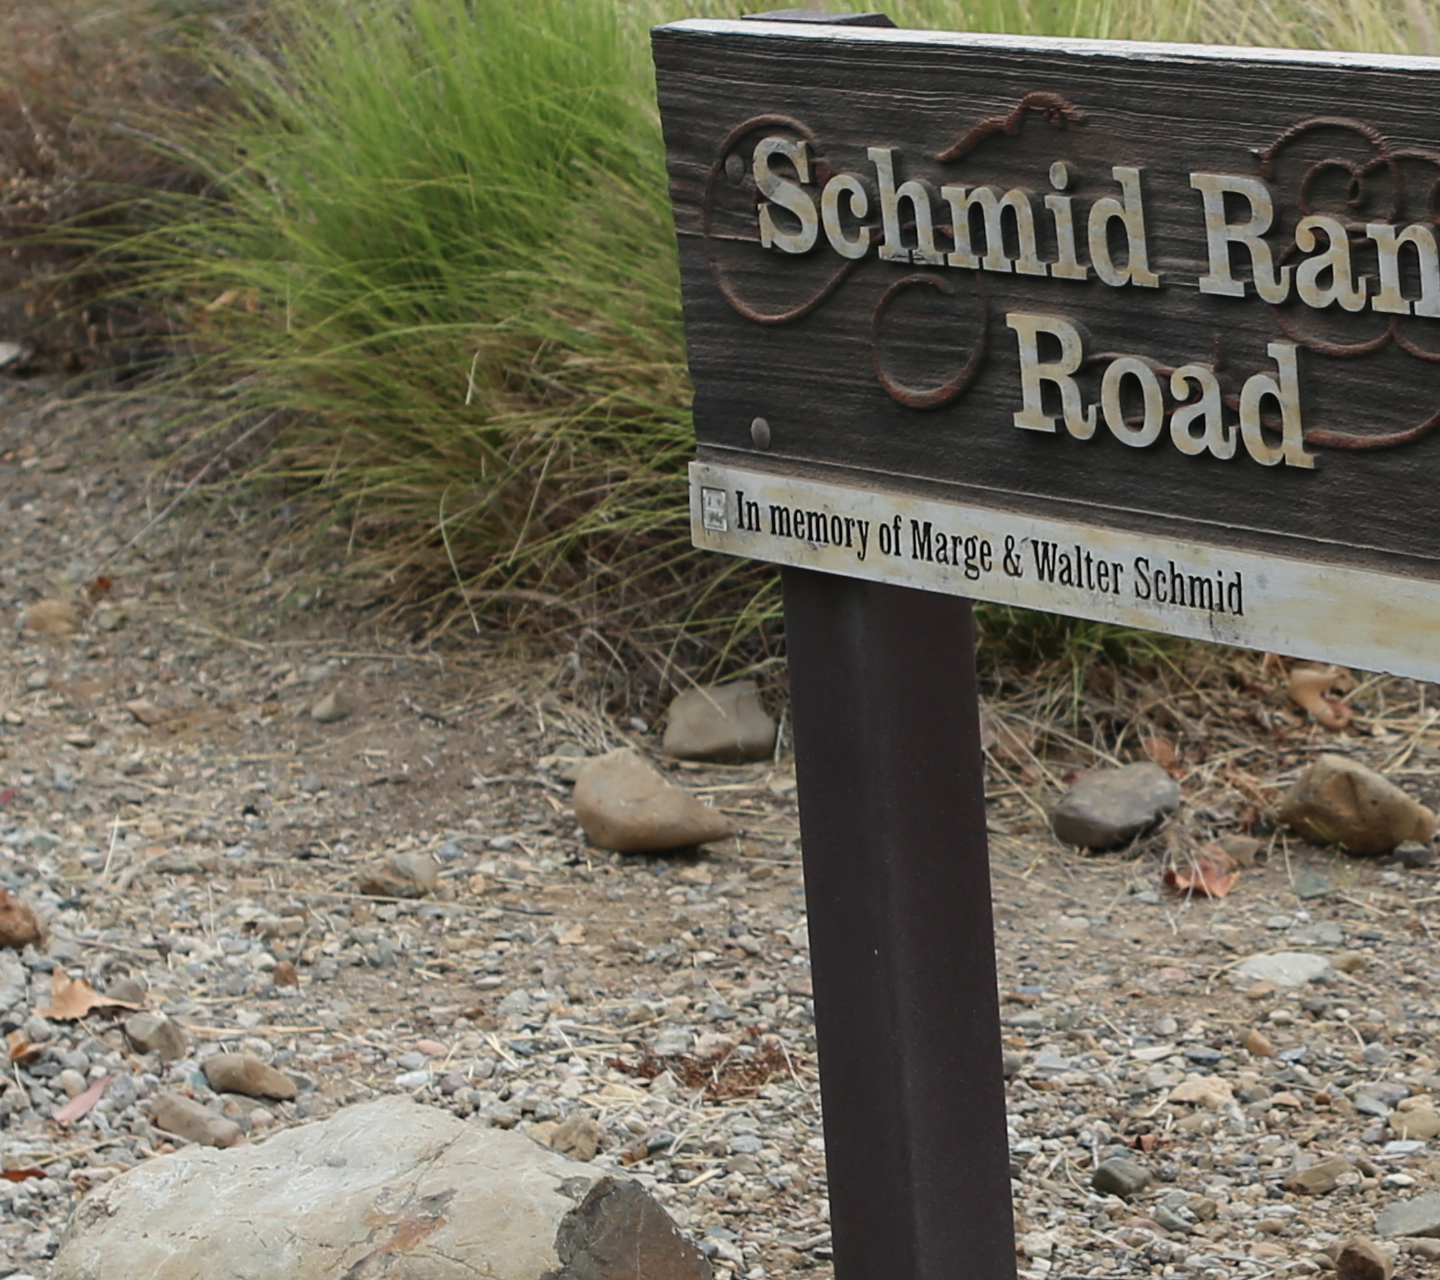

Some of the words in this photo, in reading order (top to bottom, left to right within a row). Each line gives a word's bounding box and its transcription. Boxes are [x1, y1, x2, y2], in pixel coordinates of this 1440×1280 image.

[751, 135, 1160, 289] Schmid
[1004, 312, 1319, 470] Road
[734, 490, 762, 532] In
[768, 502, 869, 562] memory
[878, 514, 903, 558] of
[909, 518, 993, 582] Marge
[1002, 535, 1024, 578] &
[1030, 539, 1126, 595] Walter
[1133, 556, 1245, 617] Schmid
